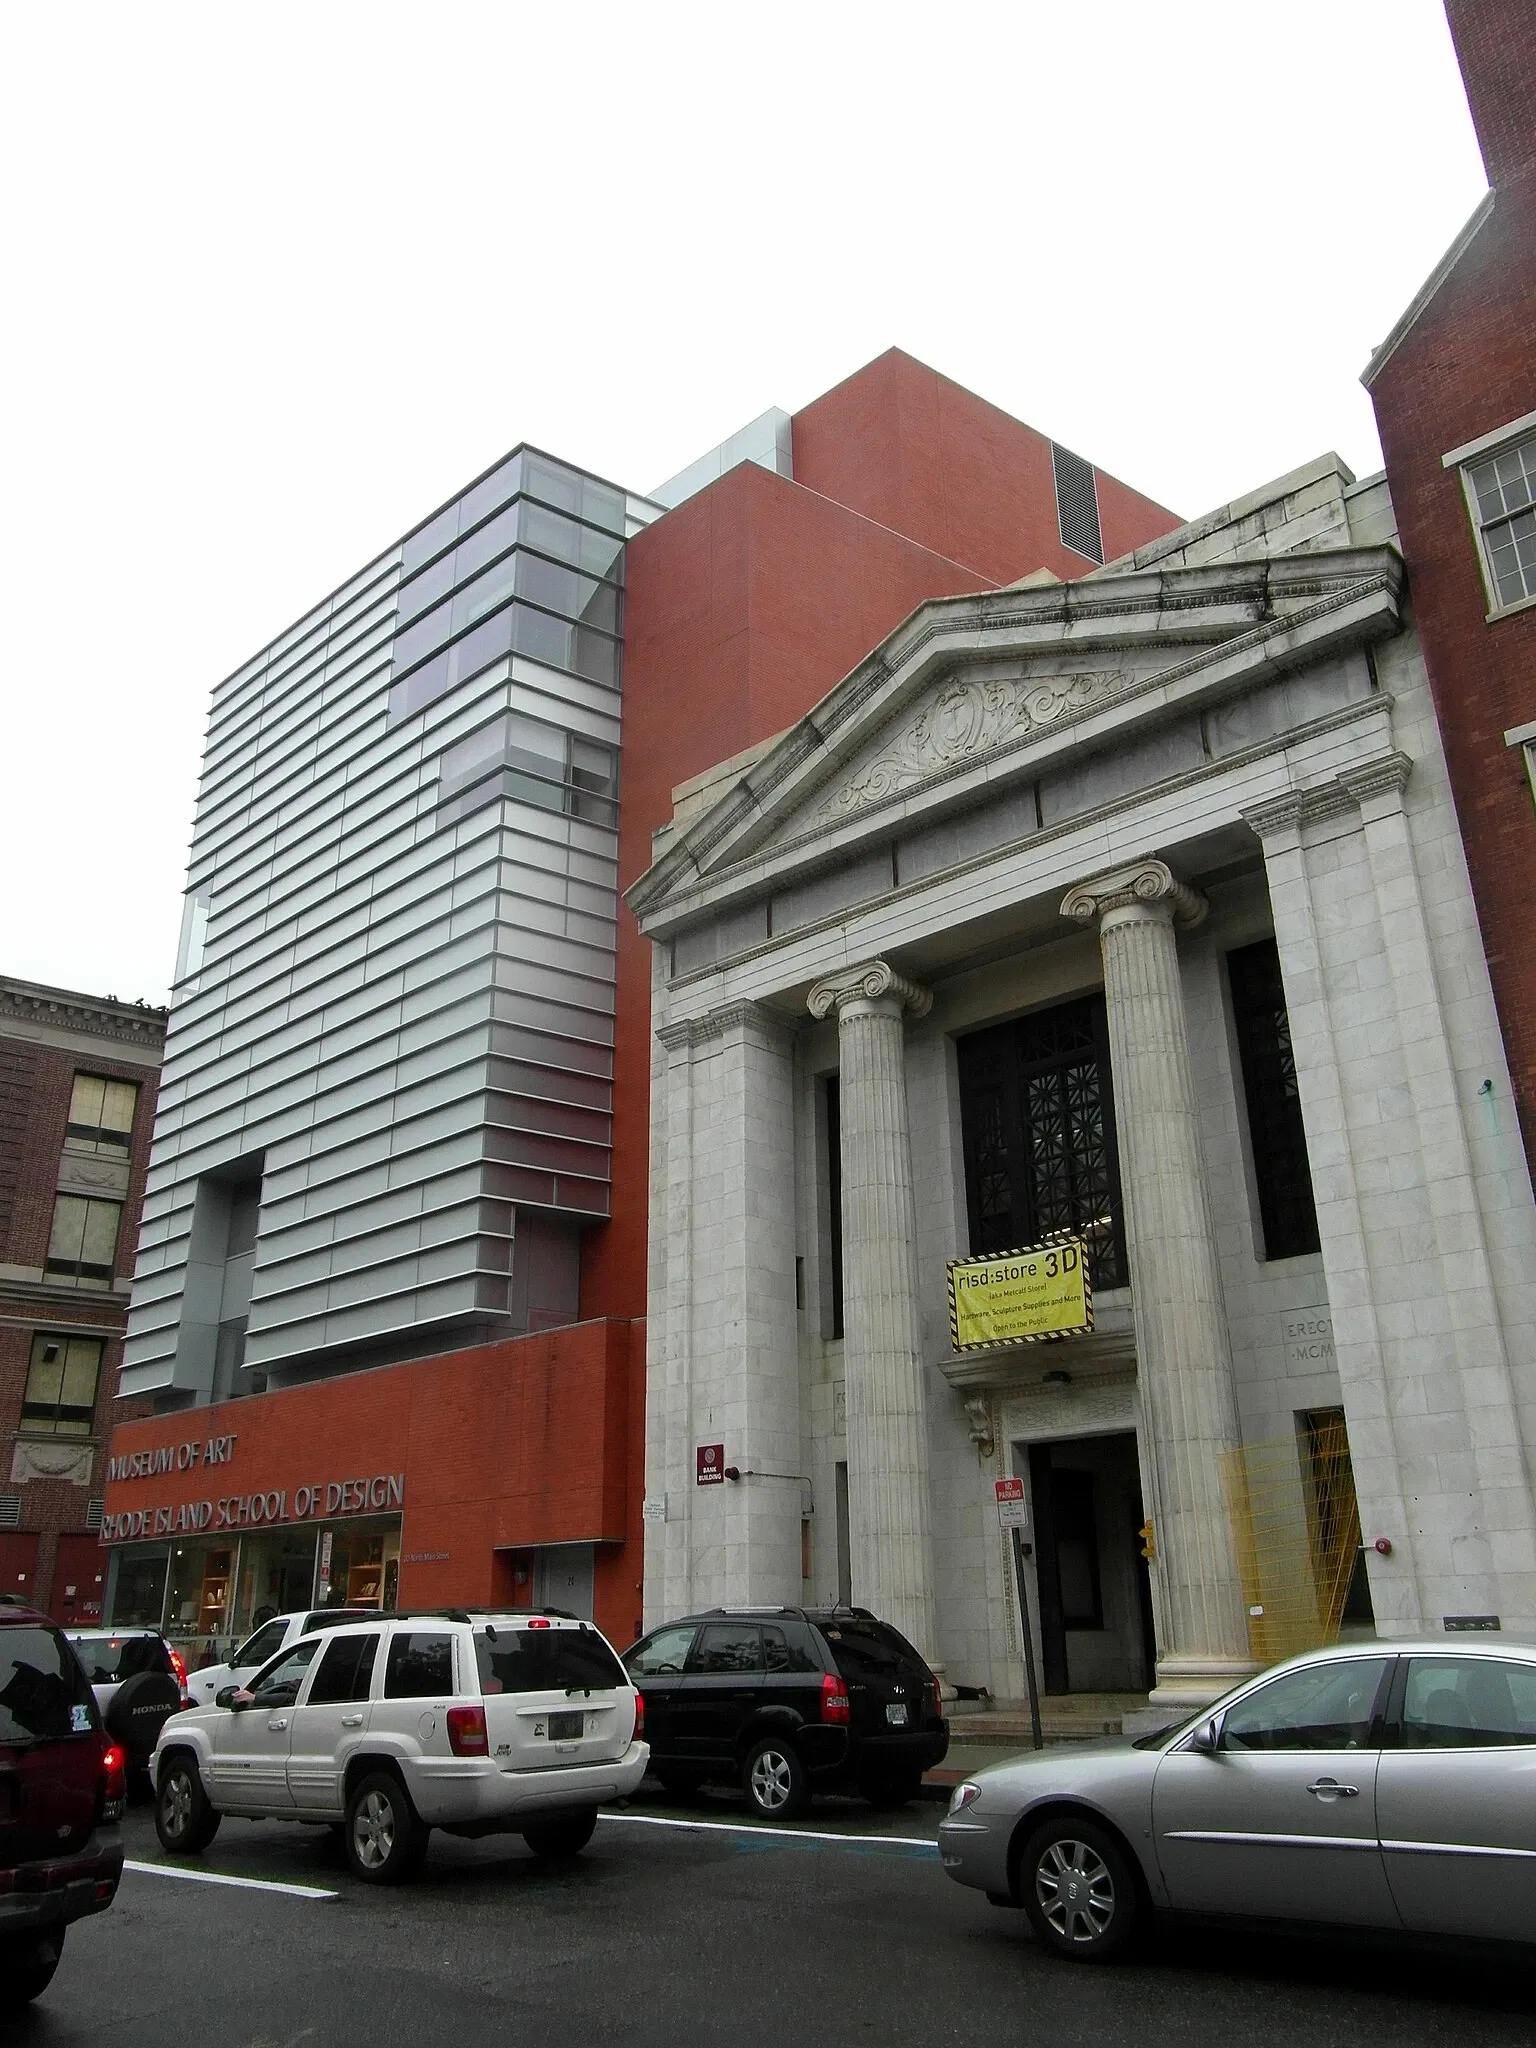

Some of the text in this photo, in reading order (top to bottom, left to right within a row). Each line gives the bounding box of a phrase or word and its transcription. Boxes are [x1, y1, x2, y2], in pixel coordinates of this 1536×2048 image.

[958, 1245, 1078, 1290] risd:store 3D
[1003, 1286, 1026, 1297] Metcalf
[992, 1304, 1022, 1316] Sculpture
[1022, 1299, 1050, 1311] Supplies
[1051, 1296, 1063, 1305] and
[1064, 1294, 1081, 1304] More
[993, 1316, 1048, 1333] Open to the Public
[106, 1434, 238, 1481] MUSEUM OF ART
[998, 1489, 1021, 1499] PARKING
[1005, 1482, 1013, 1490] NO
[99, 1473, 405, 1540] RHODE ISLAND SCHOOL OF DESIGN
[132, 1703, 173, 1716] HONDA
